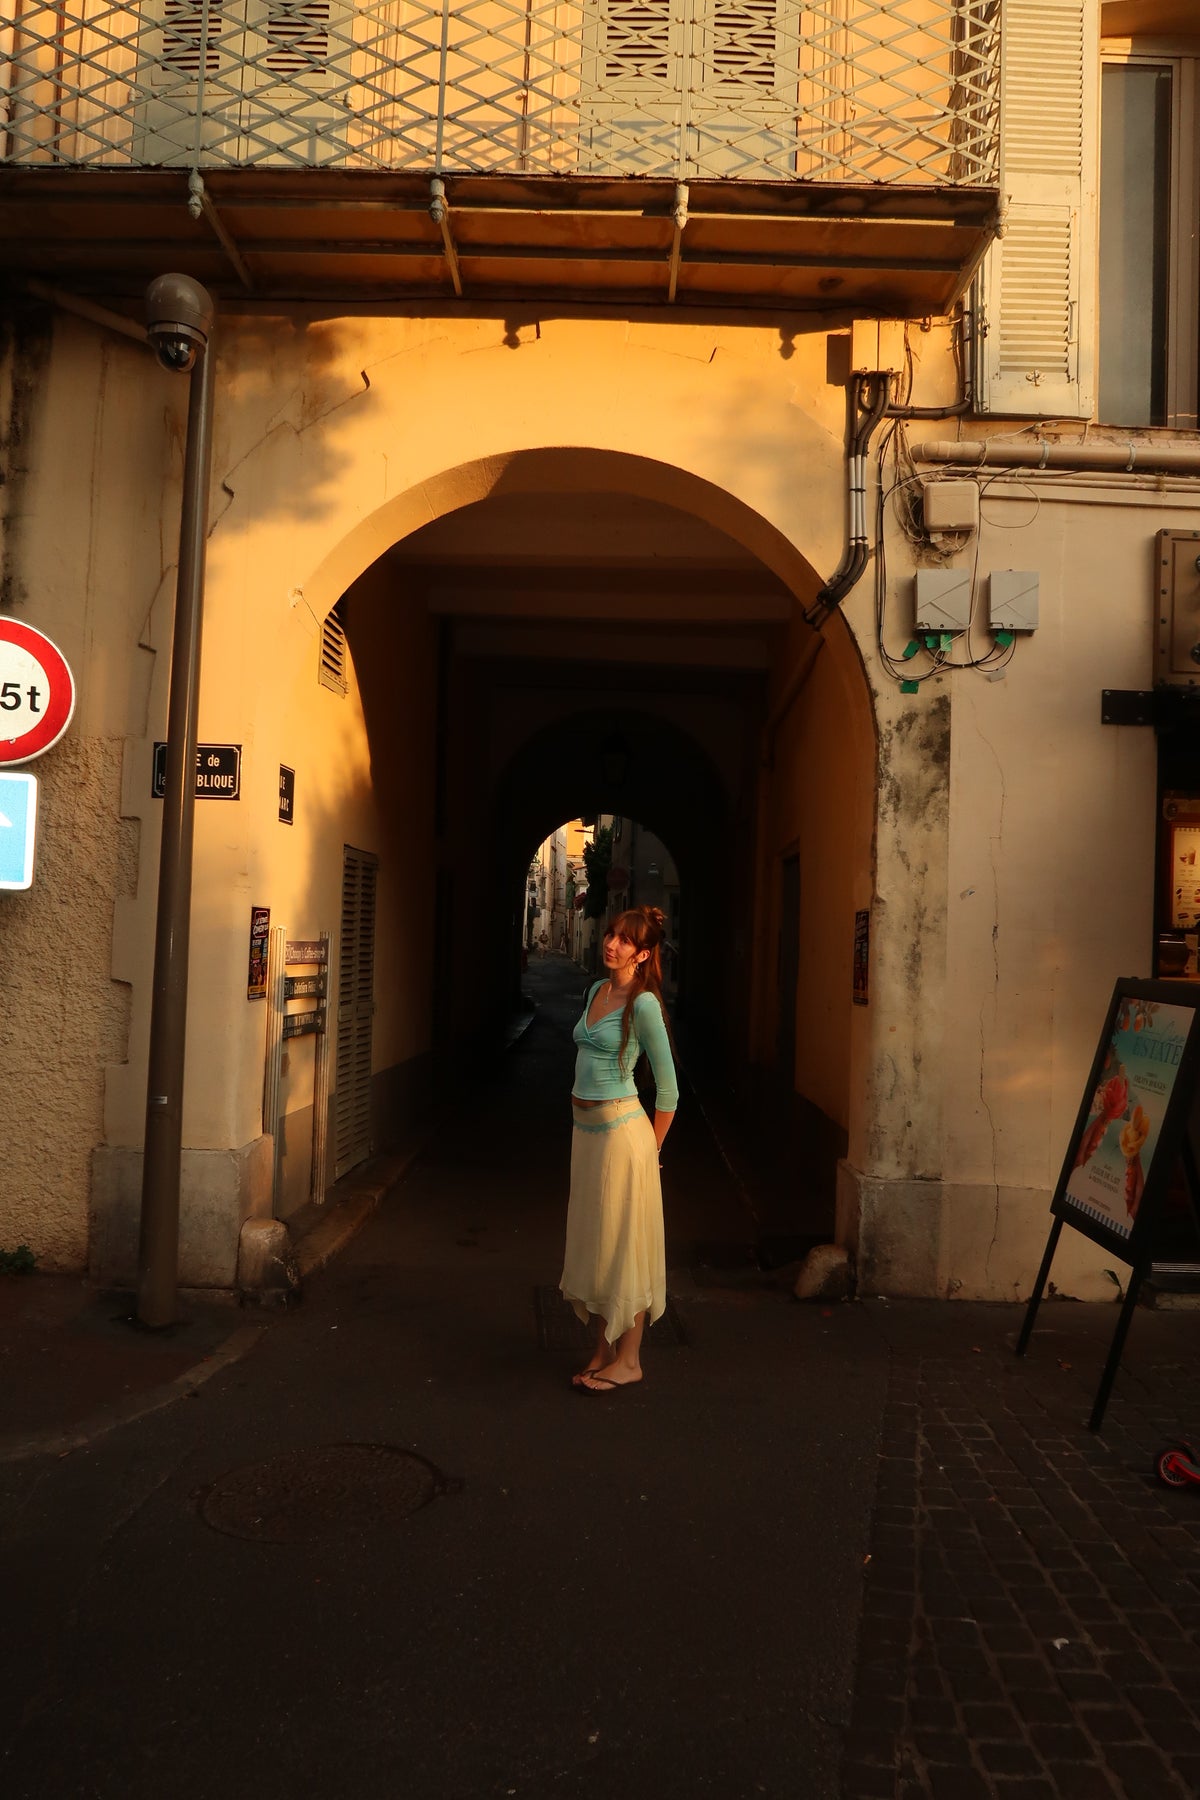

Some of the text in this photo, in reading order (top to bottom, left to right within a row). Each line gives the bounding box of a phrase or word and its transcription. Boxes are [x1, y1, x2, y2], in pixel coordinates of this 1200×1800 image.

[207, 754, 220, 767] de
[196, 774, 234, 789] BLIQUE
[279, 795, 289, 812] ARC
[1132, 1036, 1183, 1066] ESTATE
